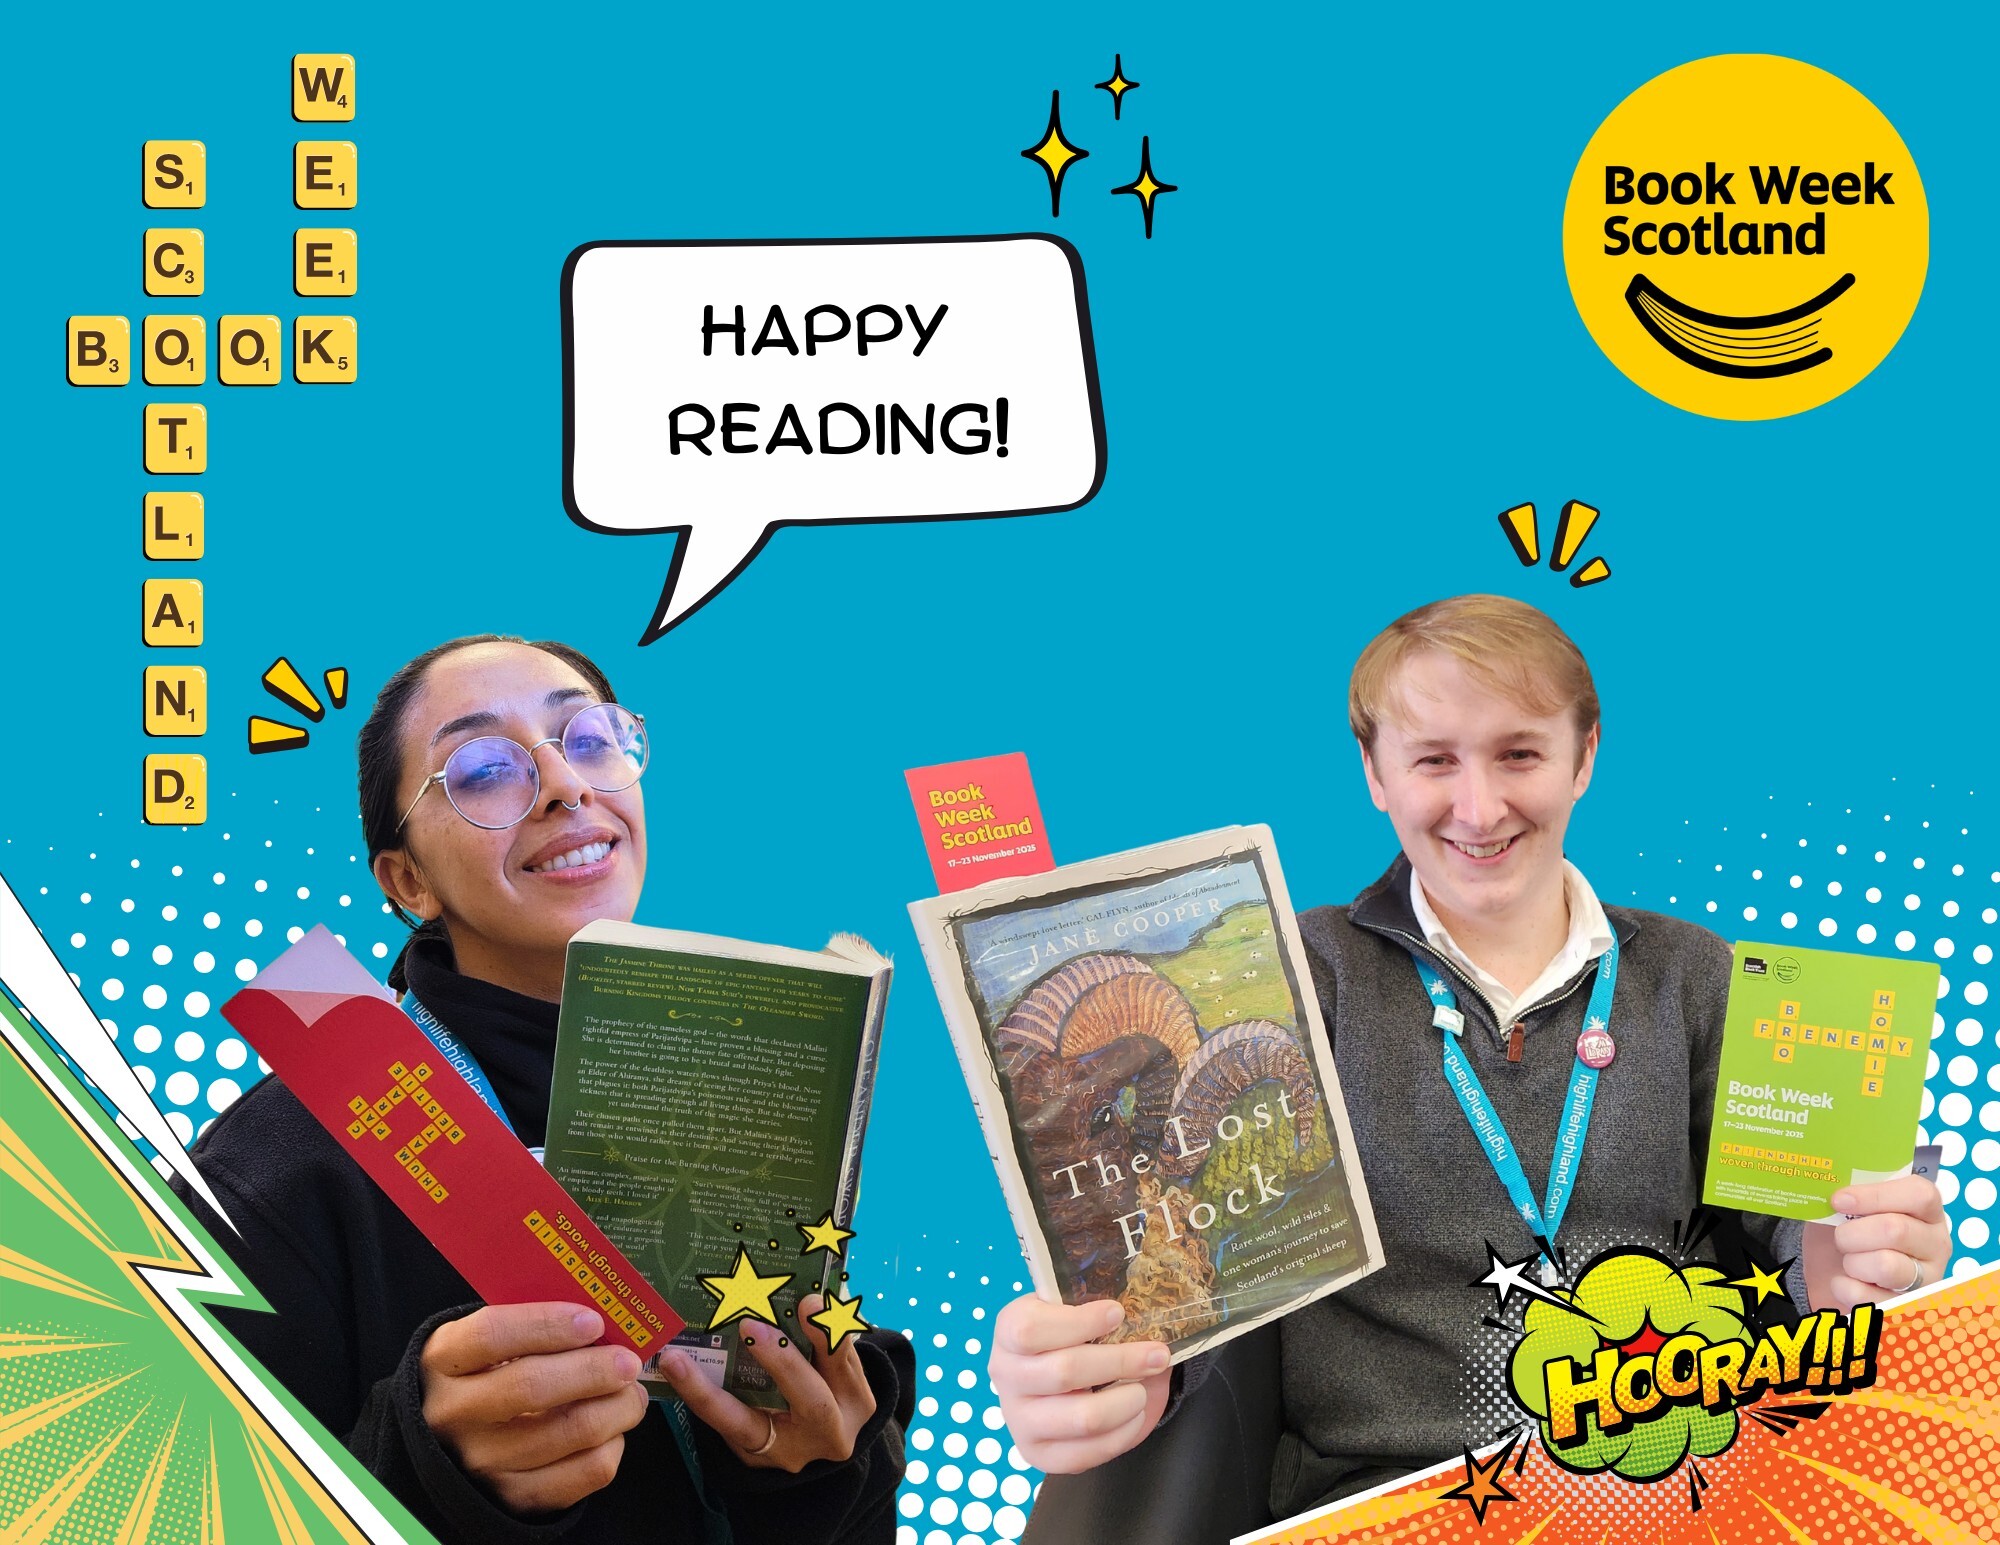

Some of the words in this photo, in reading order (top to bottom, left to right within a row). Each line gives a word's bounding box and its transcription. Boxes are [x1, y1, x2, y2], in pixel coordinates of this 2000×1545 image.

[928, 782, 986, 808] Book
[933, 803, 998, 828] Week
[940, 816, 1033, 850] Scotland
[972, 849, 1015, 864] November
[1015, 844, 1036, 855] 2025
[999, 929, 1041, 944] windswept
[1042, 926, 1057, 935] love
[1086, 911, 1106, 923] CAL
[1134, 900, 1159, 910] author
[1029, 931, 1101, 965] JANE
[1113, 898, 1222, 938] COOPER
[584, 1015, 599, 1023] The
[601, 1017, 634, 1029] prophecy
[659, 1024, 691, 1034] nameless
[692, 1029, 706, 1038] god
[730, 1033, 751, 1042] words
[770, 1038, 801, 1048] declared
[803, 1043, 827, 1052] Malini
[1758, 1022, 1909, 1054] FRENEMY
[1866, 993, 1892, 1094] HOMIE
[595, 1060, 617, 1069] power
[642, 1065, 674, 1075] deathless
[676, 1070, 699, 1078] waters
[701, 1073, 719, 1081] flows
[721, 1076, 750, 1086] through
[752, 1080, 776, 1090] Priya's
[778, 1083, 801, 1092] blood.
[803, 1086, 821, 1094] Now
[1728, 1080, 1777, 1102] Book
[1780, 1087, 1834, 1110] Week
[574, 1108, 594, 1117] Their
[596, 1111, 620, 1120] chosen
[622, 1114, 640, 1124] paths
[661, 1120, 684, 1130] pulled
[686, 1123, 704, 1131] them
[706, 1125, 726, 1135] apart.
[743, 1130, 772, 1140] Malini's
[789, 1136, 812, 1146] Priya's
[607, 1098, 618, 1107] yet
[620, 1100, 659, 1111] understand
[674, 1107, 692, 1115] truth
[718, 1113, 739, 1123] magic
[755, 1118, 782, 1127] carries.
[1726, 1100, 1810, 1126] Scotland
[1744, 1122, 1784, 1136] November
[1784, 1129, 1804, 1139] 2025
[1052, 1152, 1152, 1200] The
[1165, 1088, 1298, 1160] Lost
[1548, 1074, 1593, 1219] highlifehighland.com
[1722, 1144, 1831, 1168] FRIENDSHIP
[624, 1153, 647, 1162] Praise
[678, 1160, 709, 1171] Burning
[711, 1164, 749, 1176] Kingdoms
[1720, 1156, 1754, 1169] woven
[1757, 1161, 1800, 1178] through
[1803, 1170, 1840, 1183] words.
[838, 1167, 855, 1227] SWOR
[1112, 1162, 1286, 1261] Flock
[555, 1210, 590, 1252] words.
[1230, 1238, 1253, 1252] Rare
[1254, 1225, 1281, 1242] wool,
[1281, 1216, 1302, 1231] wild
[1302, 1209, 1322, 1222] isles
[1322, 1203, 1332, 1213] &
[1222, 1264, 1241, 1278] one
[1242, 1245, 1282, 1268] woman's
[1282, 1231, 1318, 1254] journey
[1318, 1226, 1329, 1236] to
[1330, 1218, 1349, 1231] save
[1236, 1264, 1284, 1292] Scotland's
[1285, 1248, 1322, 1268] original
[1322, 1238, 1348, 1254] sheep
[526, 1215, 650, 1345] FRIENDSHIP
[588, 1250, 632, 1298] through
[630, 1295, 664, 1332] woven
